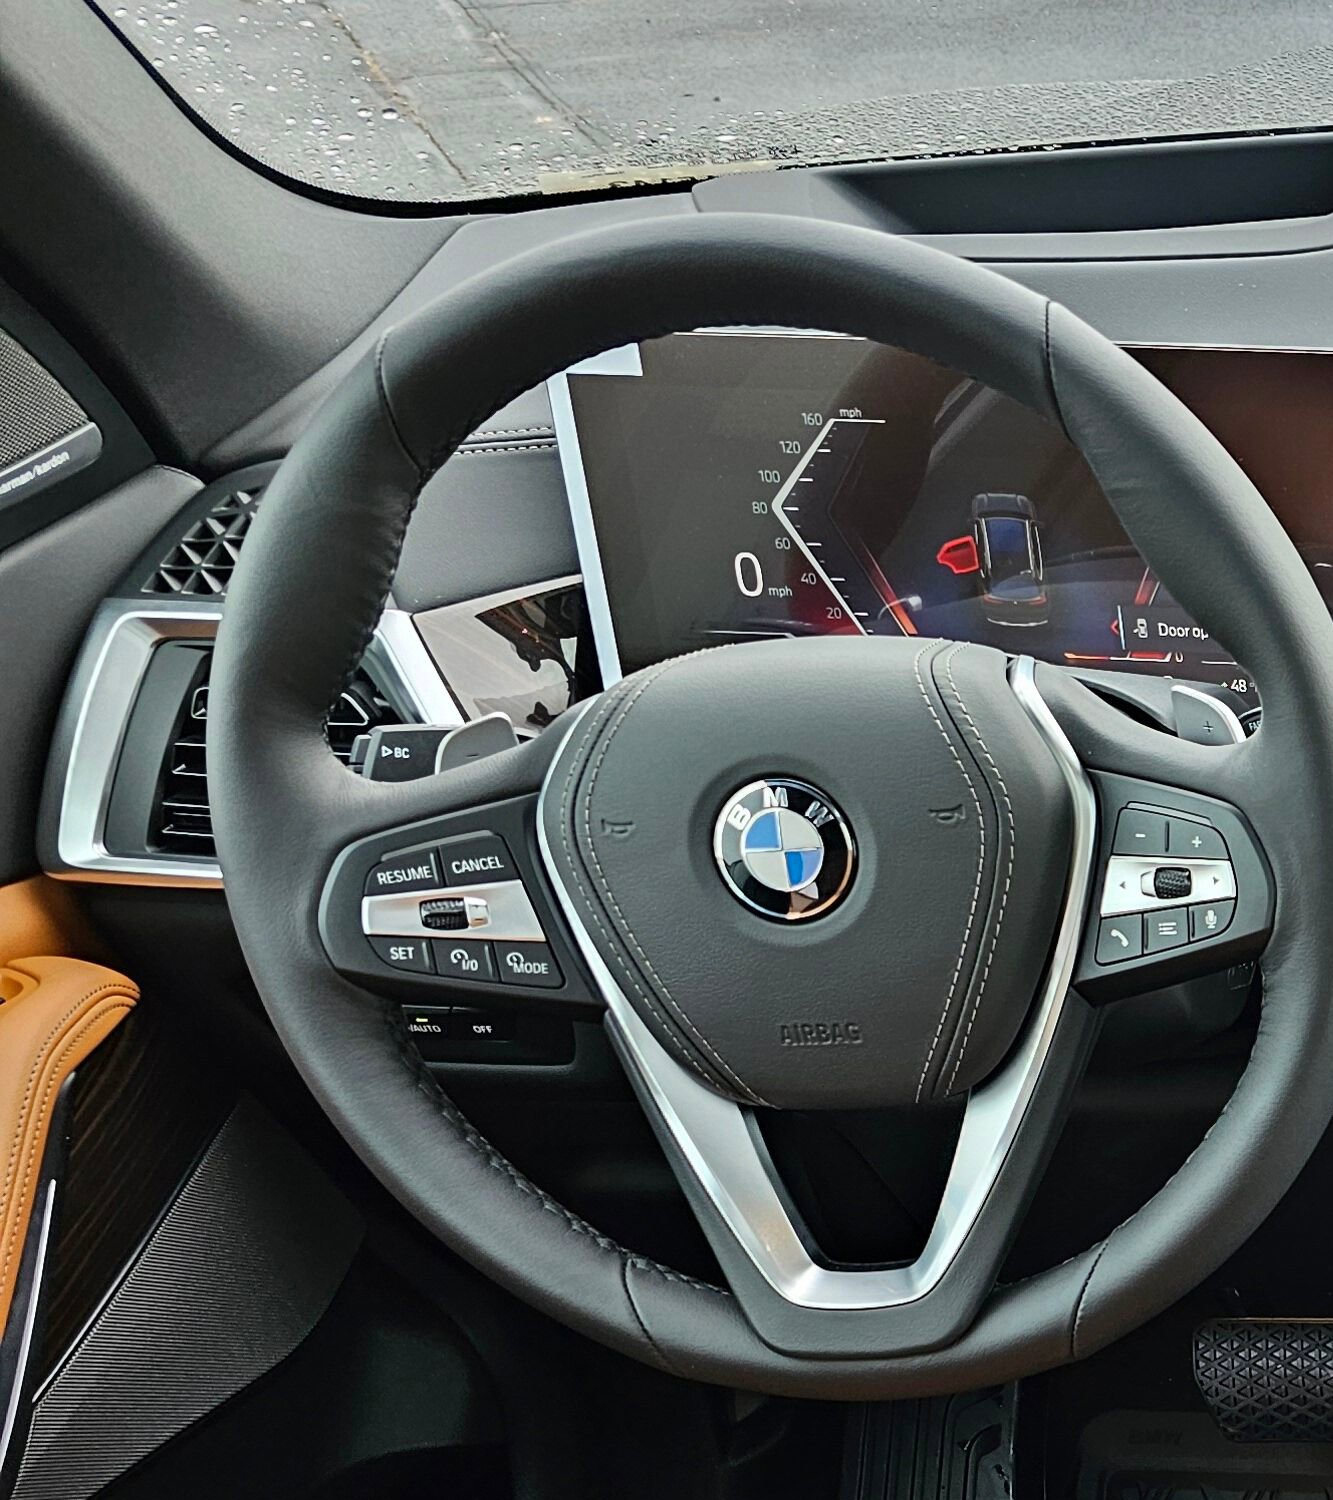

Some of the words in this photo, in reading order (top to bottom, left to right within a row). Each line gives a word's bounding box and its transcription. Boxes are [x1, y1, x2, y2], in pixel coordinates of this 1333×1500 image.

[802, 413, 823, 426] 160
[839, 408, 862, 418] mph
[779, 440, 801, 453] 120
[758, 470, 781, 483] 100
[752, 501, 768, 514] 80
[775, 537, 791, 550] 60
[734, 551, 764, 597] 0
[768, 586, 793, 597] mph
[800, 573, 817, 585] 40
[826, 607, 842, 620] 20
[1157, 622, 1189, 637] Door
[1230, 679, 1248, 693] 48
[394, 747, 411, 760] BC
[727, 786, 834, 830] BMW
[452, 855, 505, 875] CANCEL
[377, 865, 433, 886] RESUME
[390, 946, 415, 962] SET
[462, 958, 479, 972] I/O
[513, 961, 549, 975] MODE
[472, 1025, 493, 1034] OFF
[780, 1022, 863, 1046] AIRBAG
